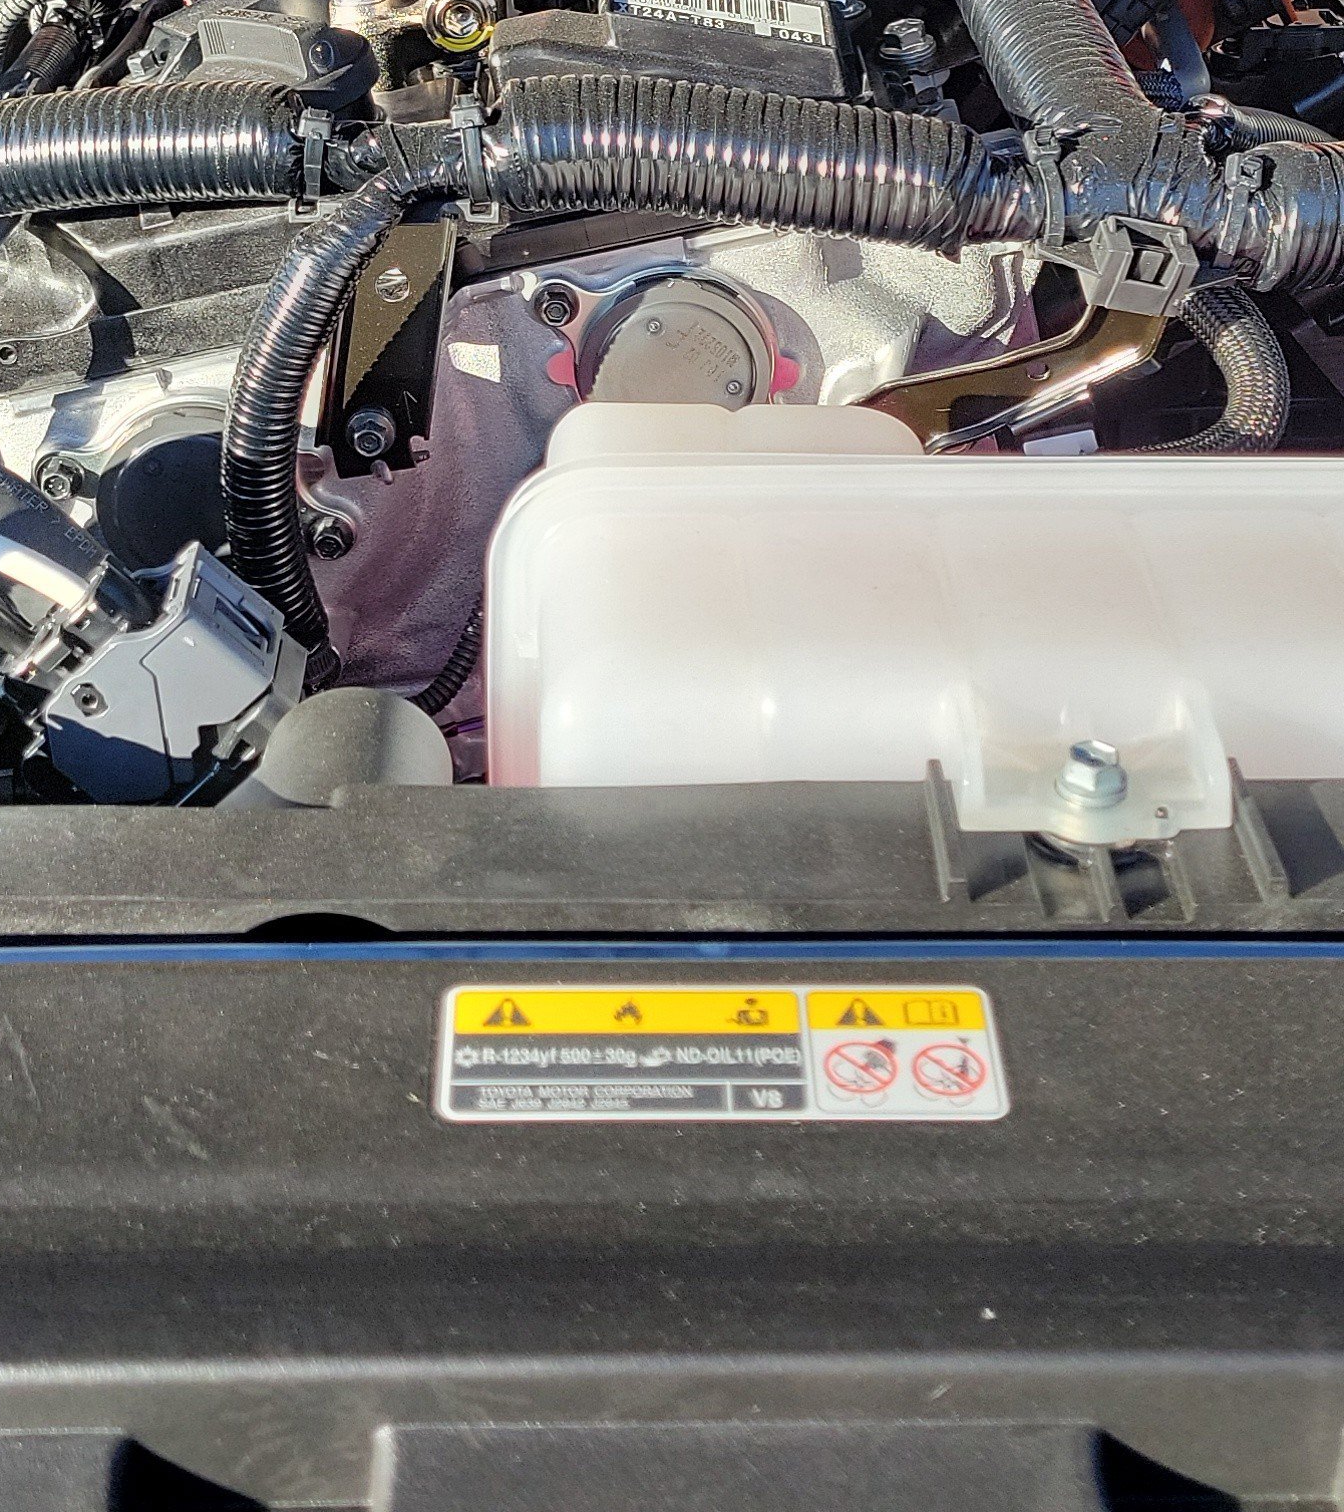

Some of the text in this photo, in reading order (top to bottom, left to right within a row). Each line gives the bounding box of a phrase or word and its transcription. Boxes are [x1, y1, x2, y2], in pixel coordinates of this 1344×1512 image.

[779, 30, 814, 44] 043
[483, 1047, 556, 1068] R-1234yf
[479, 1086, 695, 1099] TOYOTA MOTOR CORPORATION
